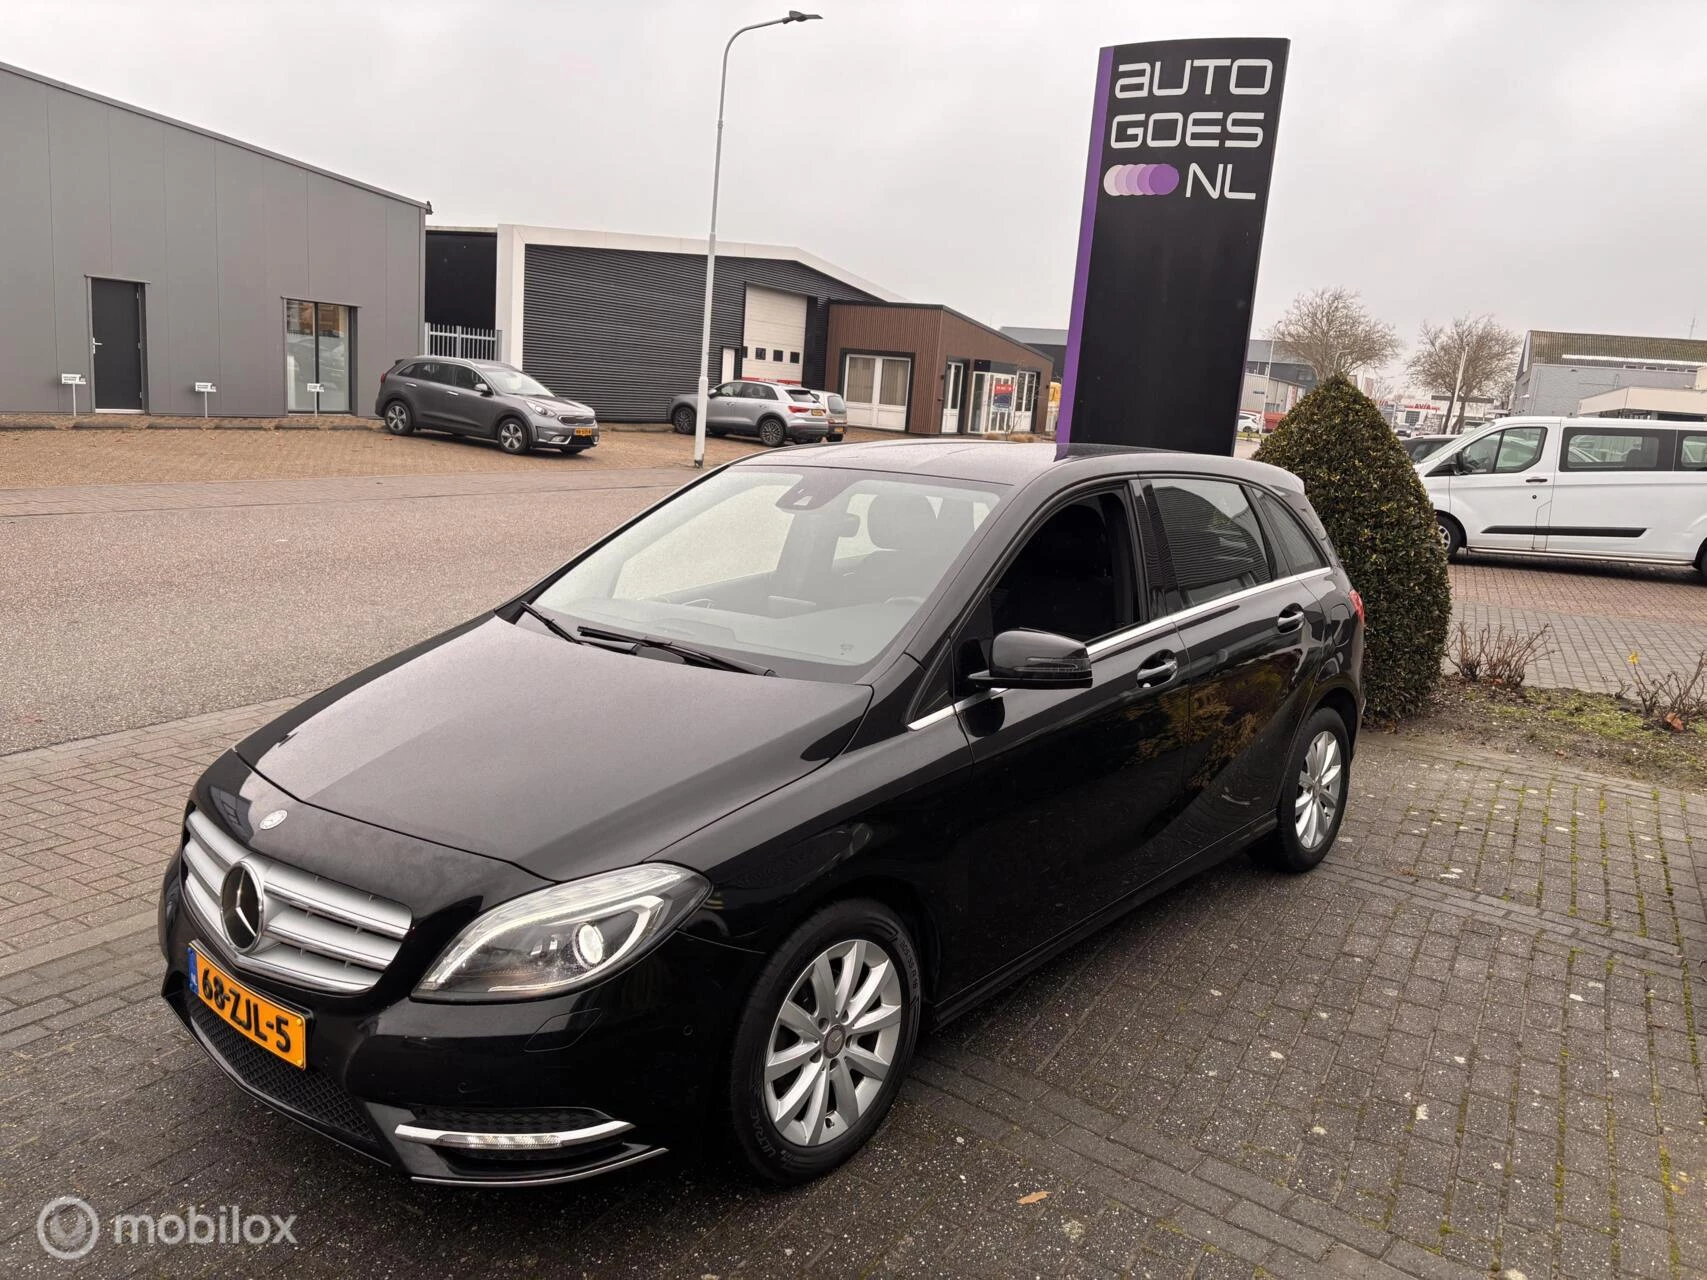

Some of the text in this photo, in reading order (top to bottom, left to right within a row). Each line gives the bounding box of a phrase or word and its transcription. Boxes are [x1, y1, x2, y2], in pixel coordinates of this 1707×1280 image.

[1110, 111, 1265, 149] GOES
[1185, 162, 1257, 200] NL
[202, 967, 292, 1053] 68-ZJL-5
